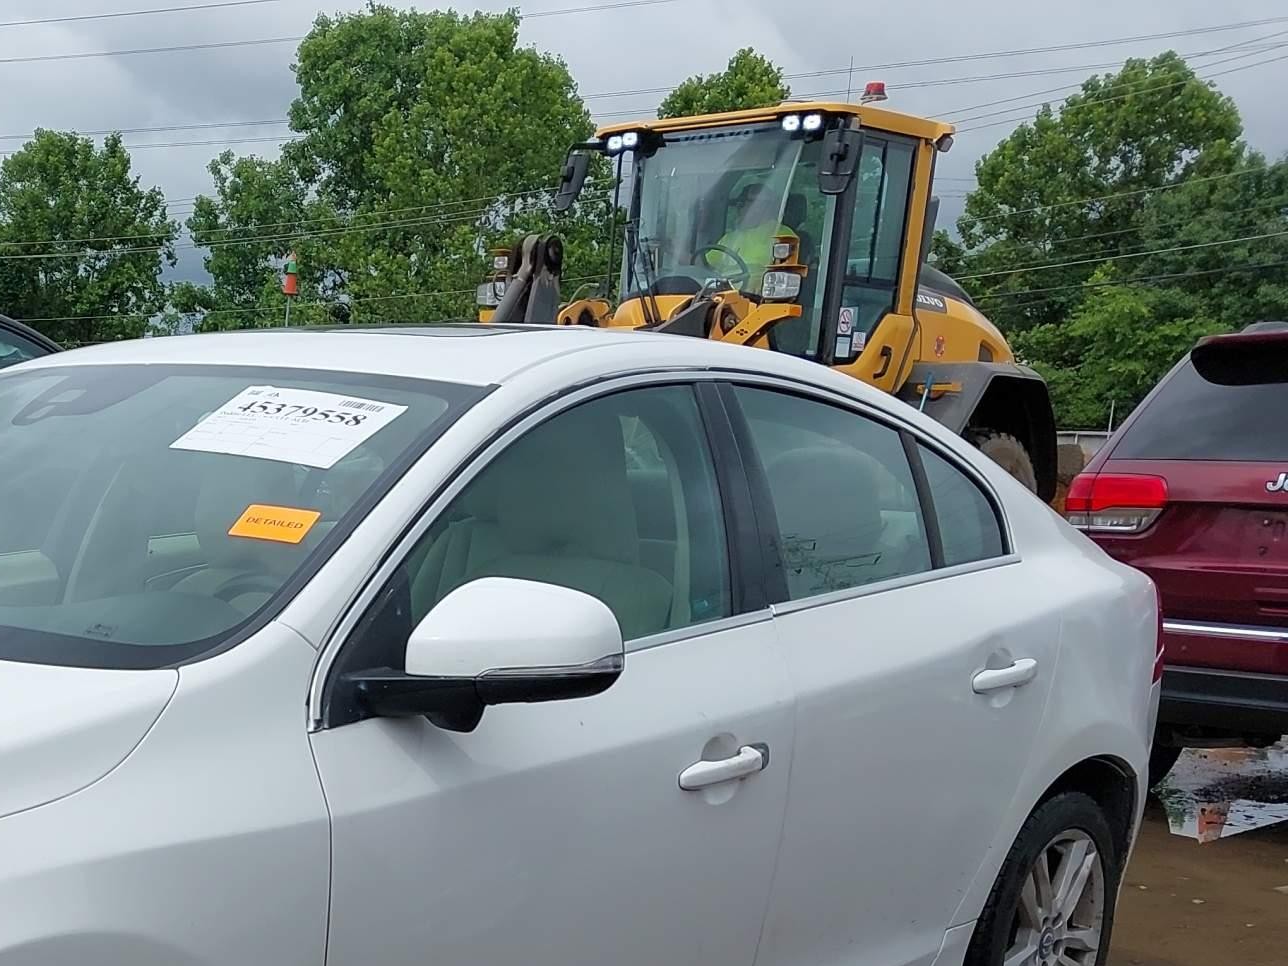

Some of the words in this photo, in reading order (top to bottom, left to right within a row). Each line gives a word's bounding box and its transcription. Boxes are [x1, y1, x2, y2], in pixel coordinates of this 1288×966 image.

[917, 294, 944, 308] OLVO
[237, 400, 369, 427] 45379558
[246, 516, 304, 529] DETAILED
